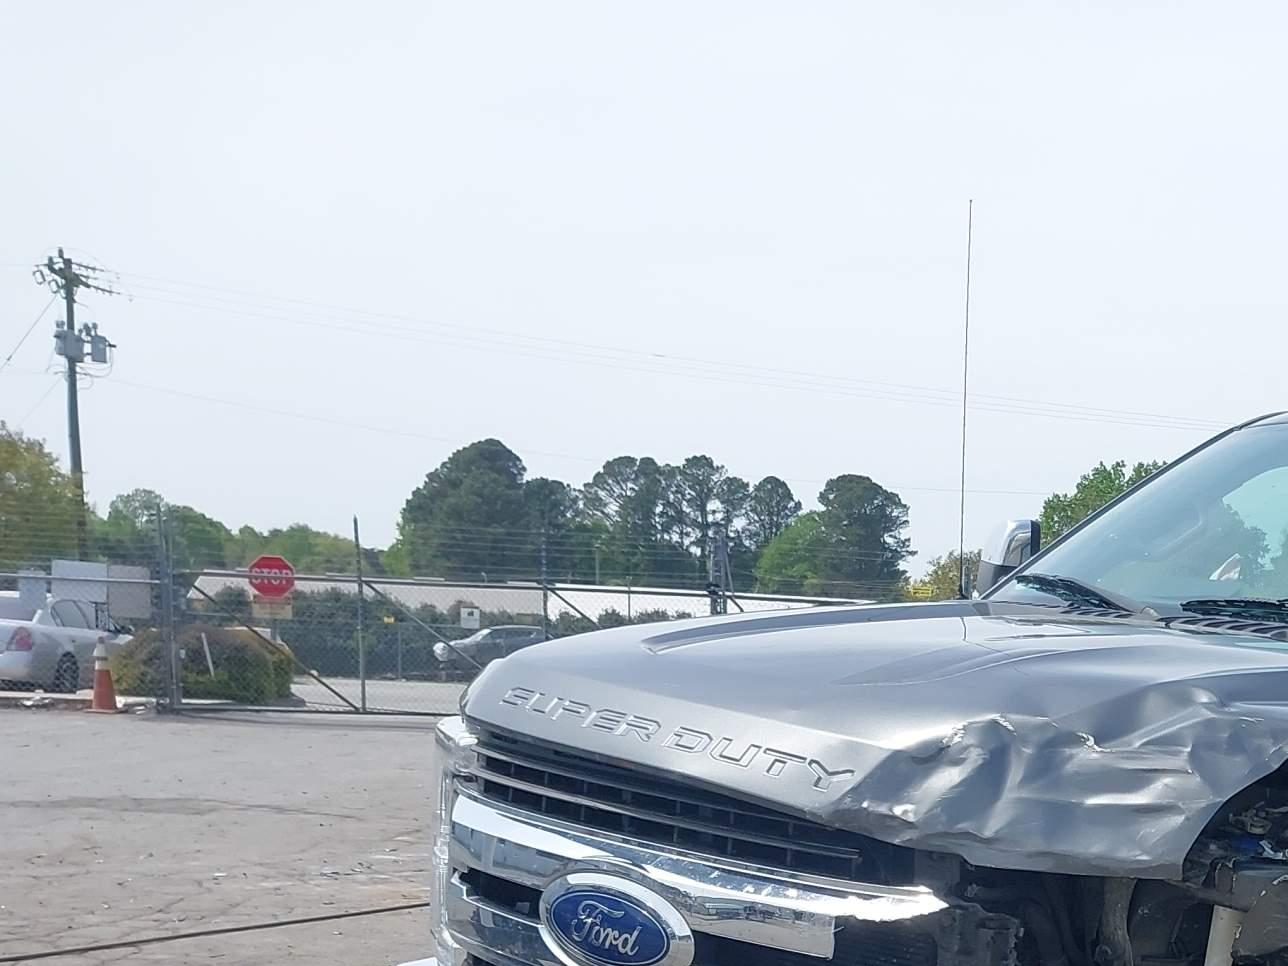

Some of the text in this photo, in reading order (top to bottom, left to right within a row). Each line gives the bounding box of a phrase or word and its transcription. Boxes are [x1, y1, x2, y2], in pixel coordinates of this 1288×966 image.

[251, 568, 292, 585] STOP
[499, 687, 856, 792] SUPER DUTY
[571, 900, 643, 956] Ford
